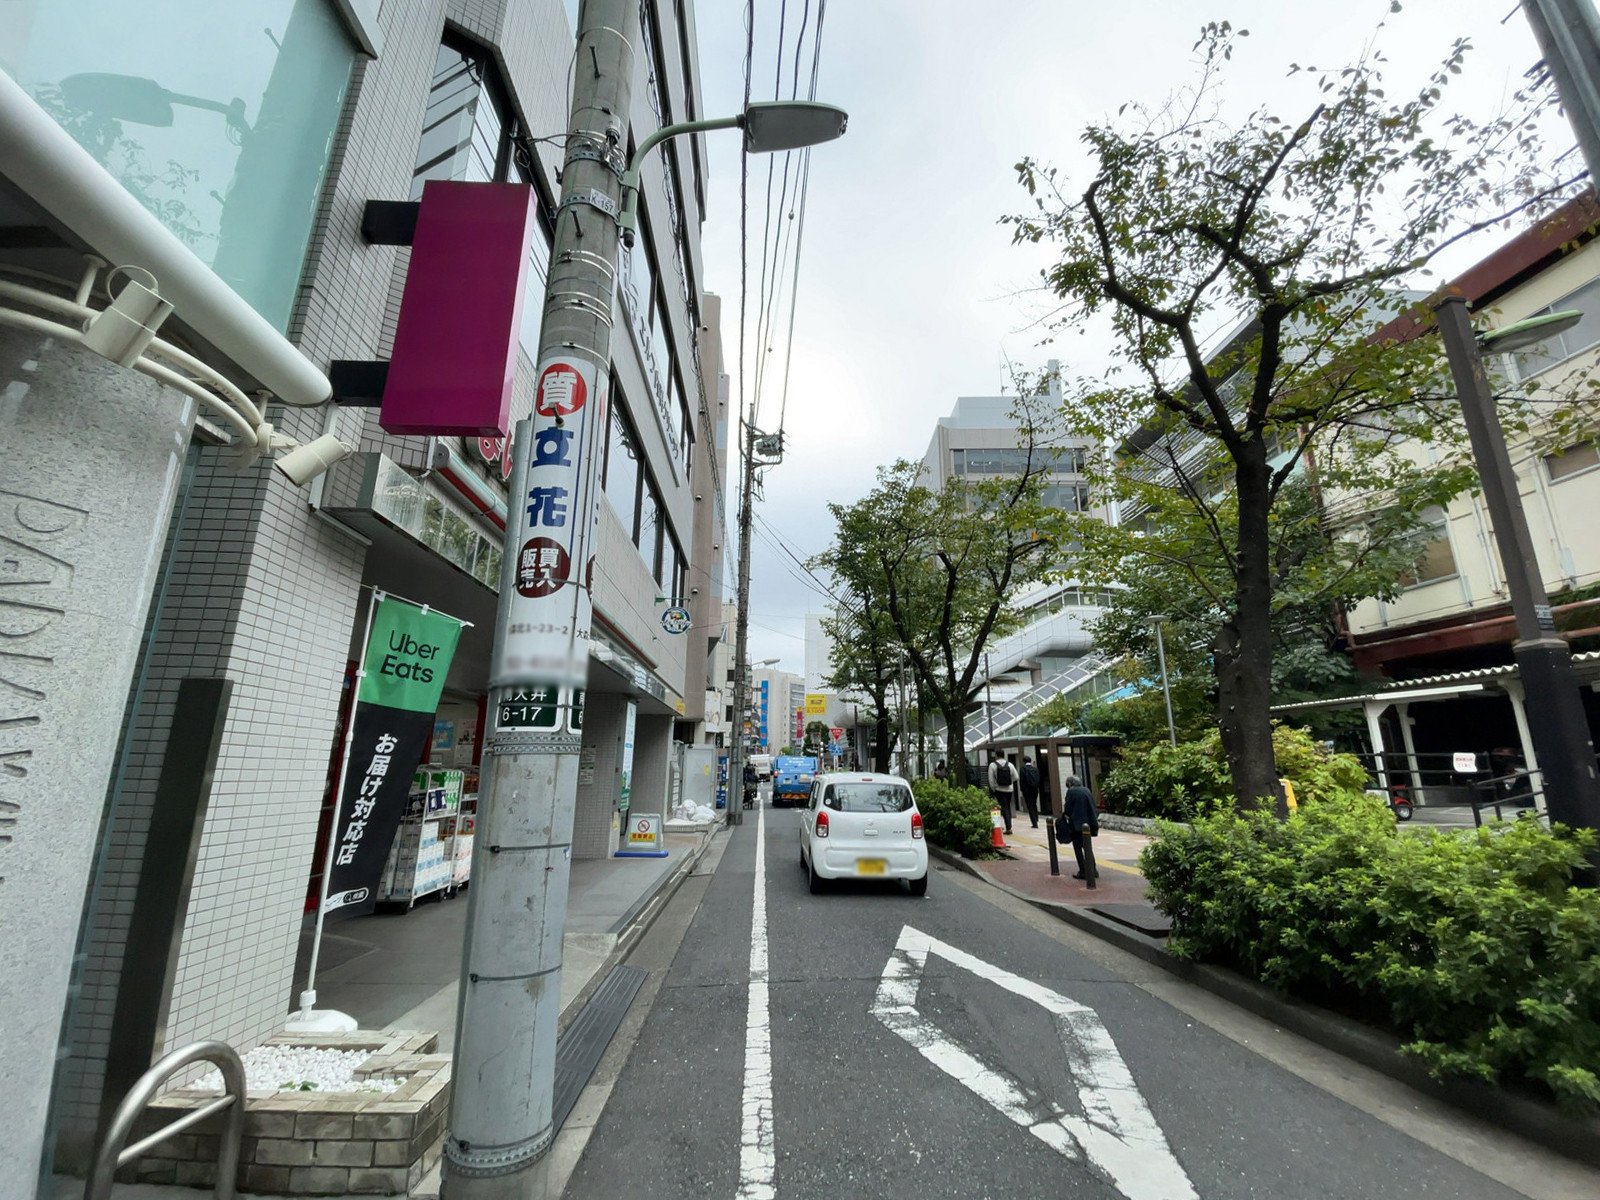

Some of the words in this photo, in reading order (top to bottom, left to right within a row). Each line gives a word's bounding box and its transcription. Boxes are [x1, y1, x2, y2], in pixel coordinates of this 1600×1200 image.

[591, 194, 613, 212] K-157
[540, 371, 577, 411] 質
[527, 427, 574, 528] 立花
[389, 630, 440, 661] Uber
[380, 654, 434, 684] Eats
[502, 706, 542, 721] 6-17
[336, 733, 398, 866] お届け対応店
